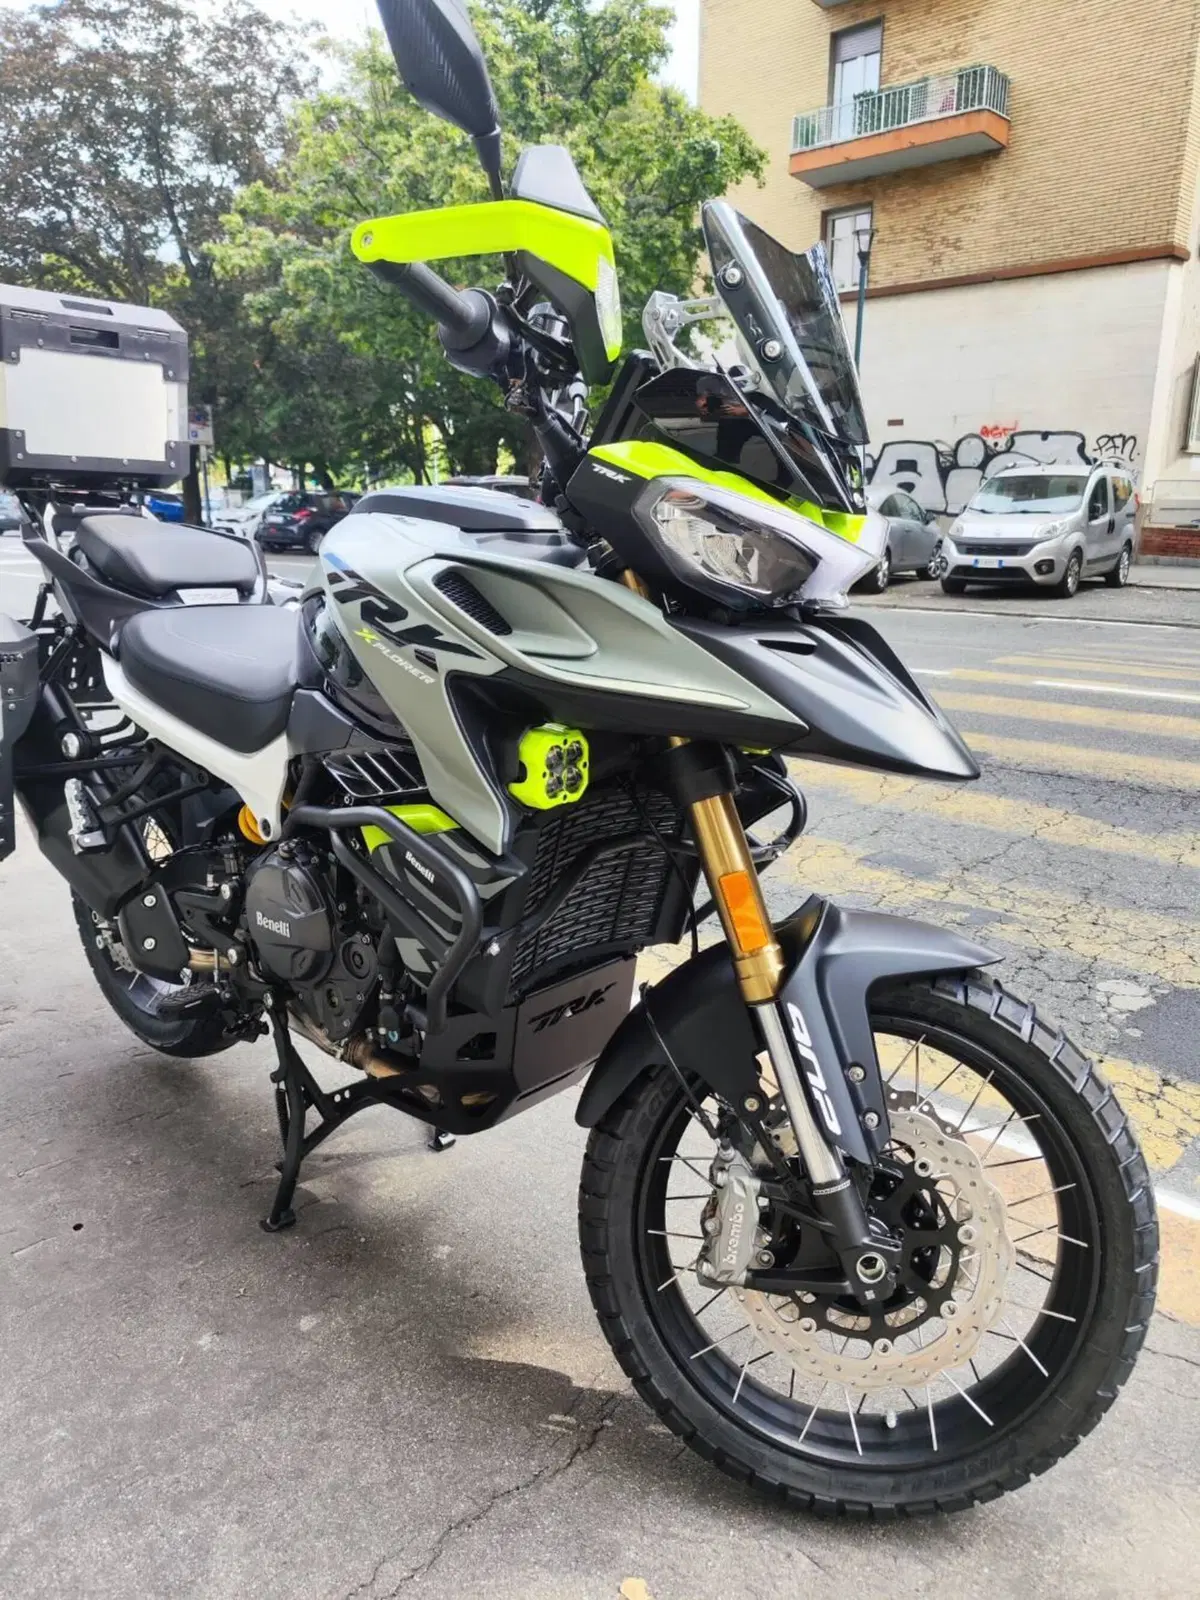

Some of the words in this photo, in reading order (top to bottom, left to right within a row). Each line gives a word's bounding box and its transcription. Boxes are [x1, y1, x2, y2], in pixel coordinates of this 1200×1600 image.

[591, 462, 632, 484] TRK
[405, 850, 435, 884] Benelli
[255, 910, 291, 939] Benelli
[527, 981, 618, 1034] TRK
[722, 1202, 745, 1265] brembo
